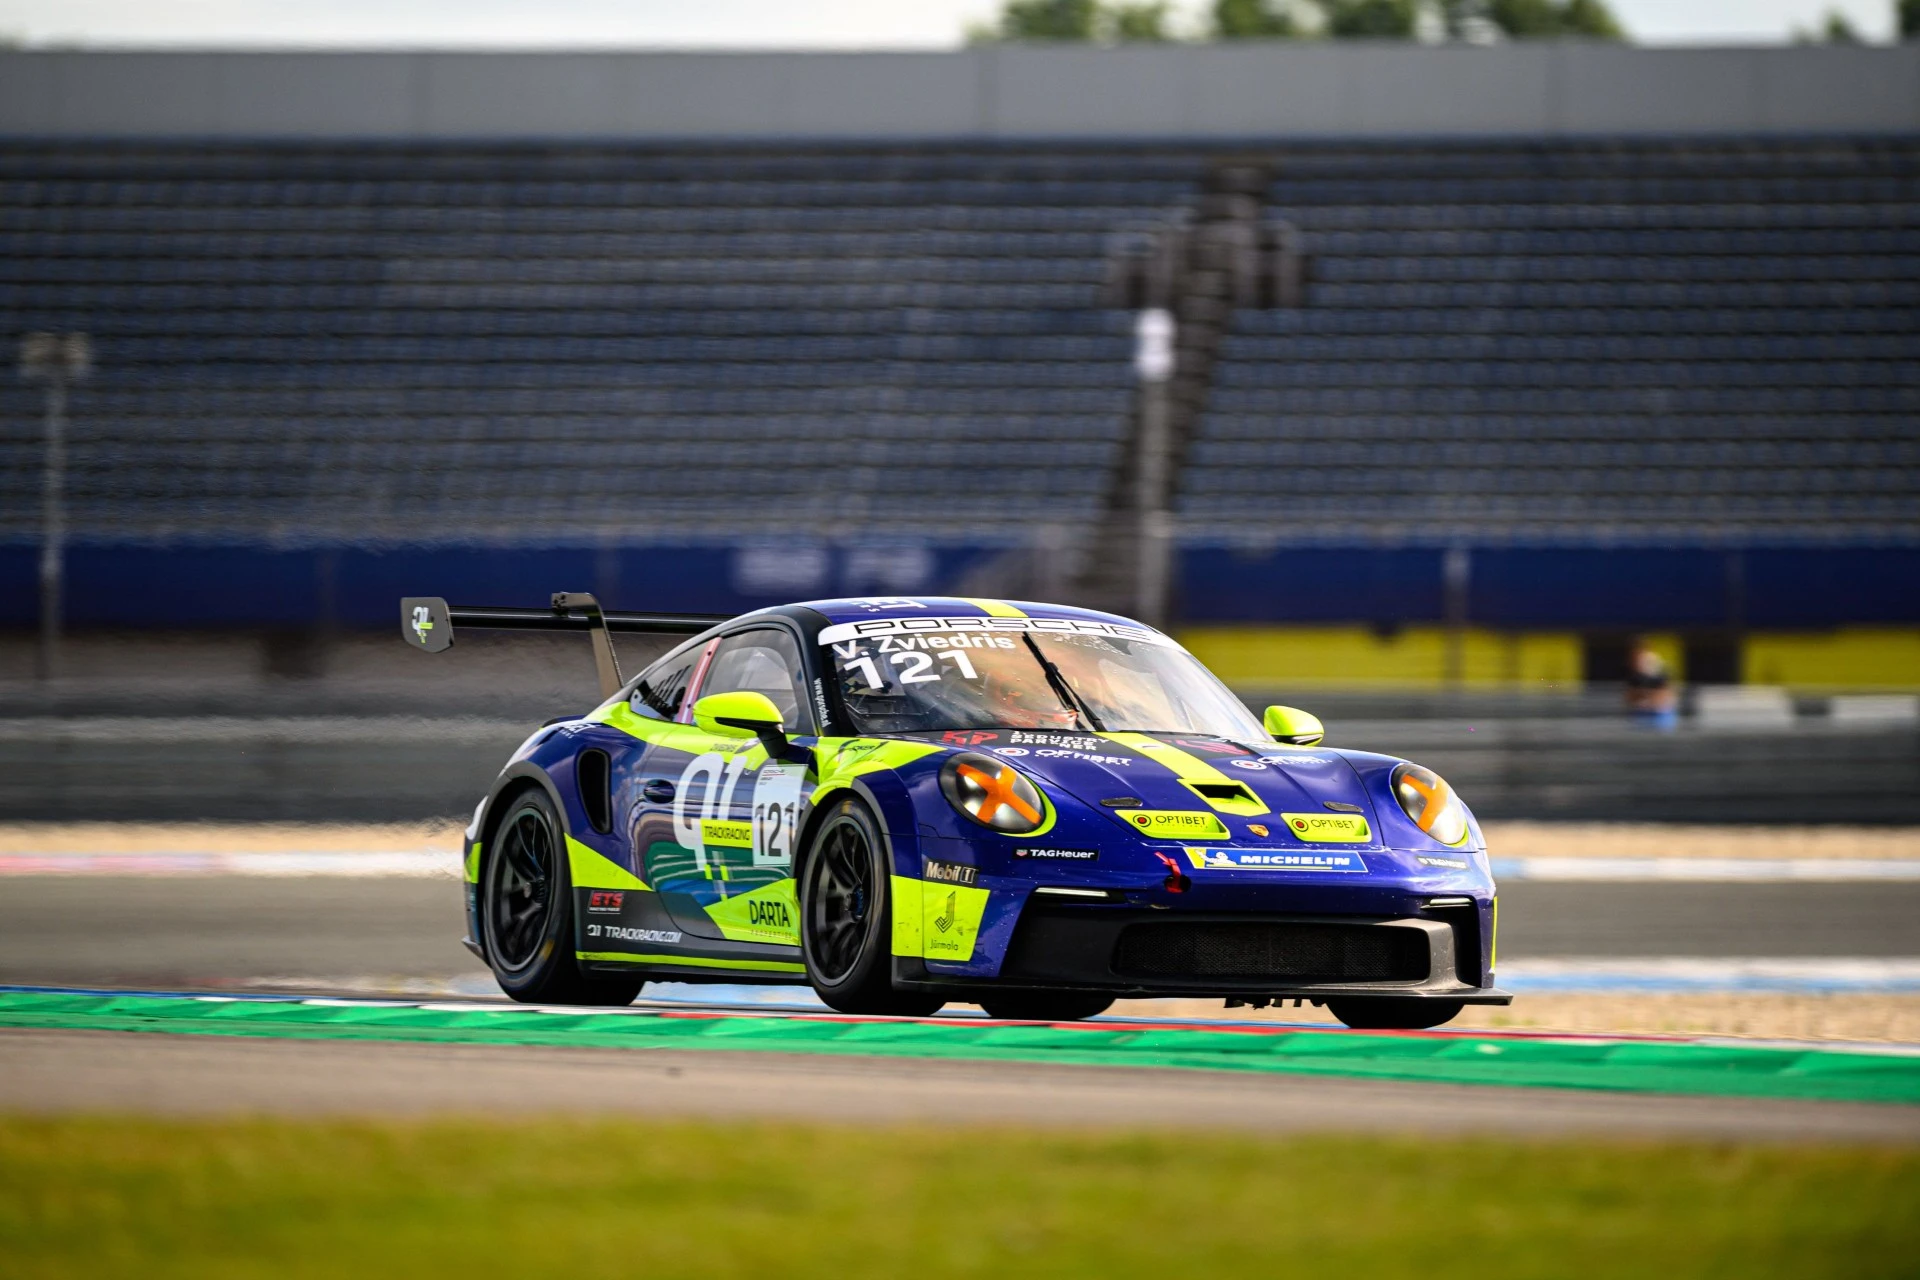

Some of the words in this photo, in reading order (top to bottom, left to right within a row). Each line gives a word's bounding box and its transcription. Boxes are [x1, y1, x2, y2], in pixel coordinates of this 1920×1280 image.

[854, 617, 1151, 641] PORSCHE
[871, 633, 1017, 654] Zviedris
[843, 649, 978, 690] 121
[755, 802, 796, 857] 121
[1156, 815, 1206, 825] OPTIBET
[1310, 820, 1355, 829] OPTIBET
[704, 826, 750, 841] TRACKRACING
[926, 861, 961, 881] Mobil
[1240, 856, 1350, 866] MICHELIN
[590, 892, 624, 908] ETS
[749, 900, 791, 927] DARTA
